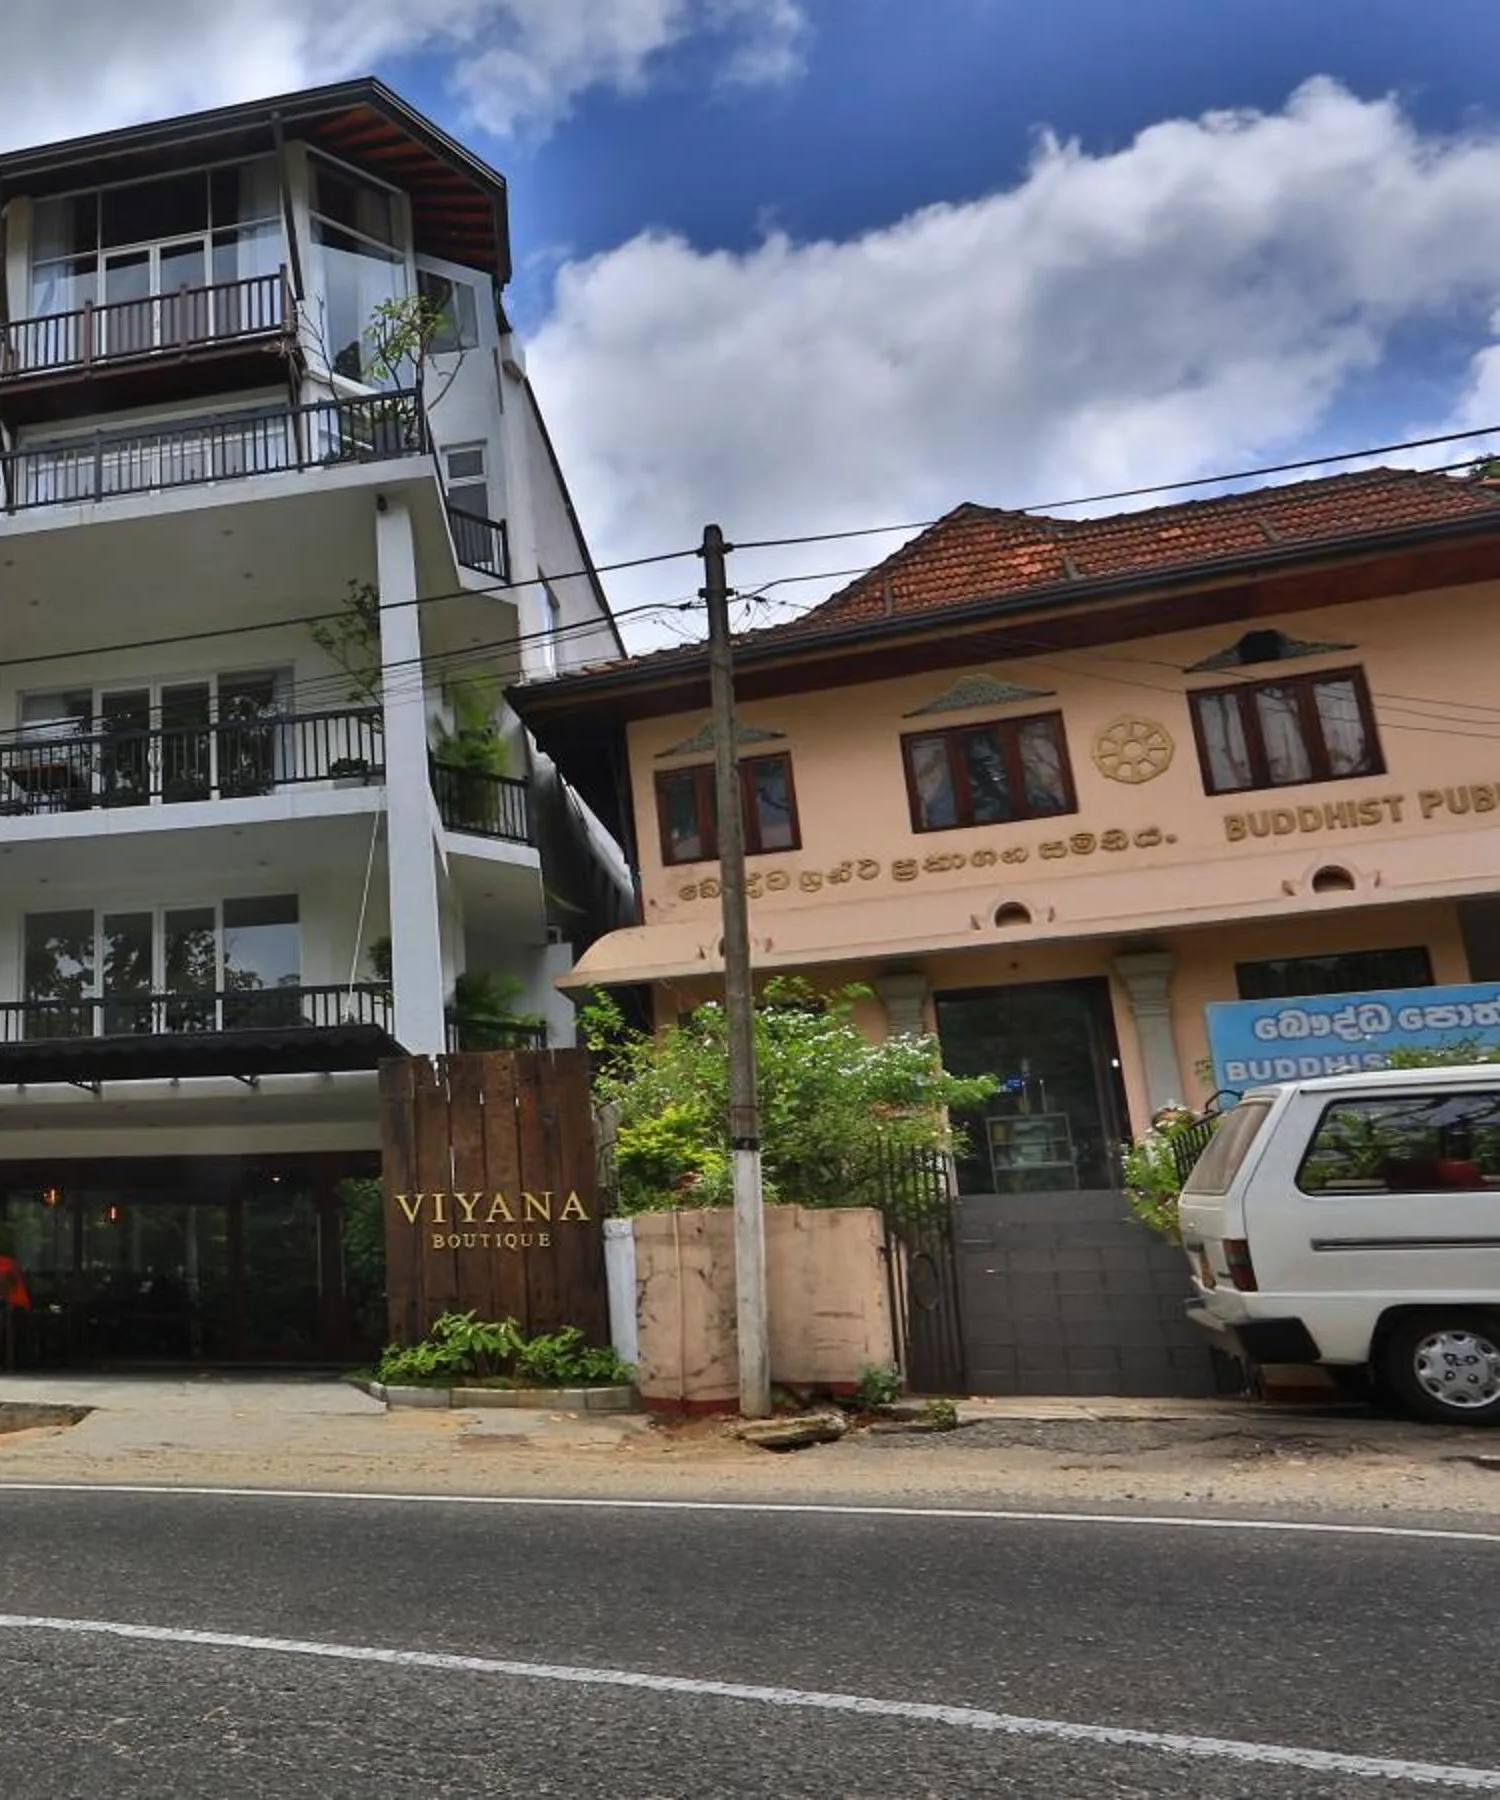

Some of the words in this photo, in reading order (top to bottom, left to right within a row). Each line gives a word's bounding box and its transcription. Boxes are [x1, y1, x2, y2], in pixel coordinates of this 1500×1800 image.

[1224, 794, 1405, 842] BUDDHIST
[1253, 1003, 1392, 1042] බෞද්ධ
[1225, 1053, 1387, 1082] BUDDHIS
[396, 1190, 591, 1224] VIYANA
[433, 1233, 551, 1250] BOUTIQUE
